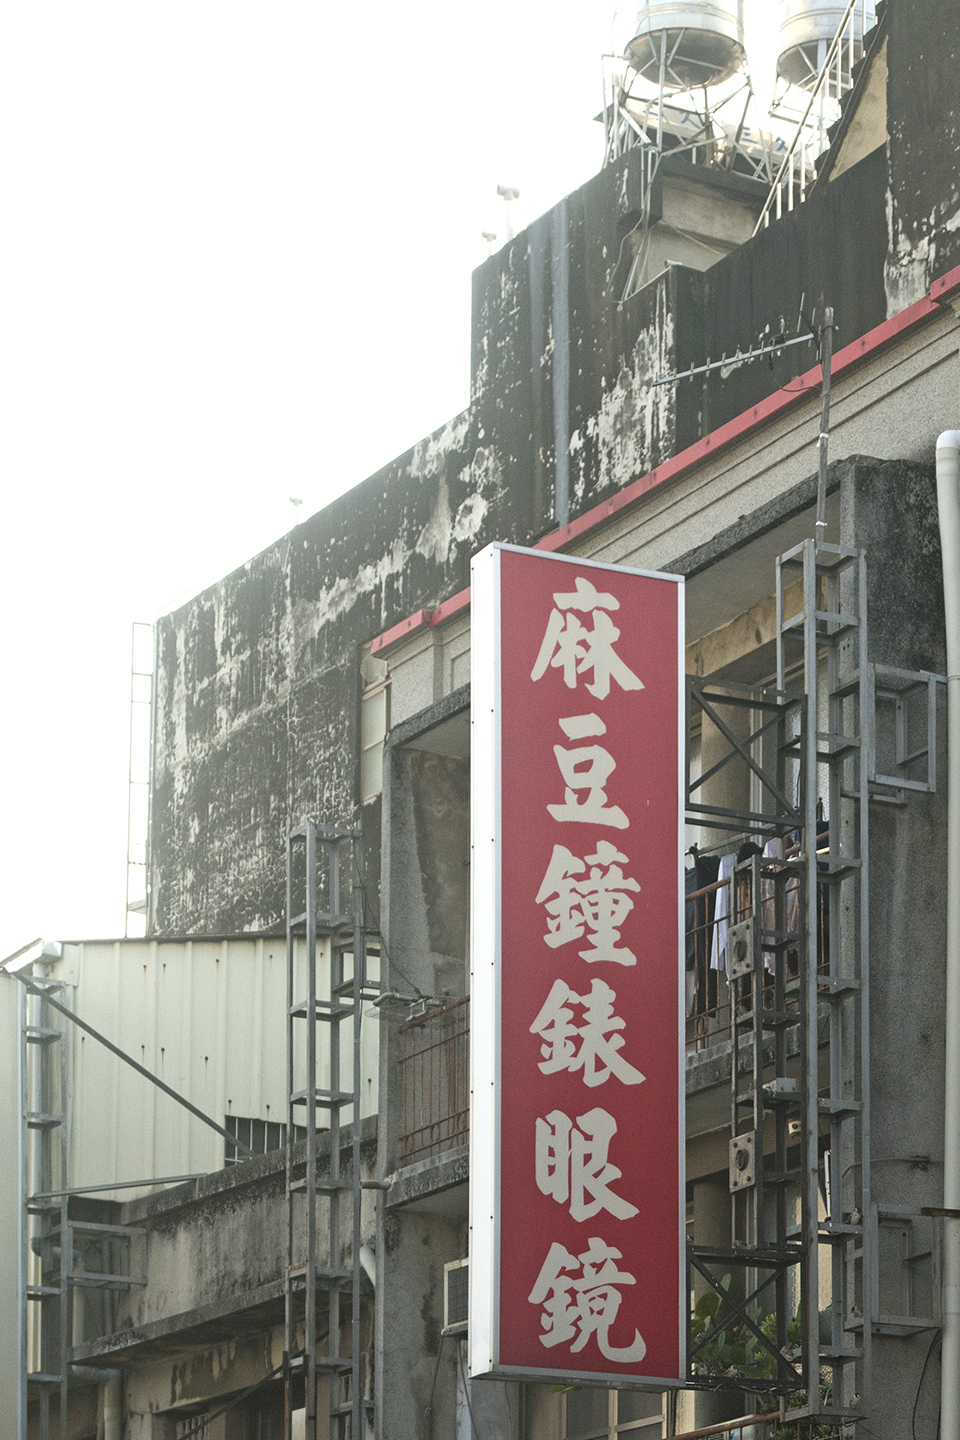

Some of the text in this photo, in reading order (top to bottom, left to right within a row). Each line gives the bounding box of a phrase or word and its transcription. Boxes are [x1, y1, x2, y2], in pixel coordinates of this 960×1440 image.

[528, 577, 647, 1365] 麻豆鐘錶眼鏡
